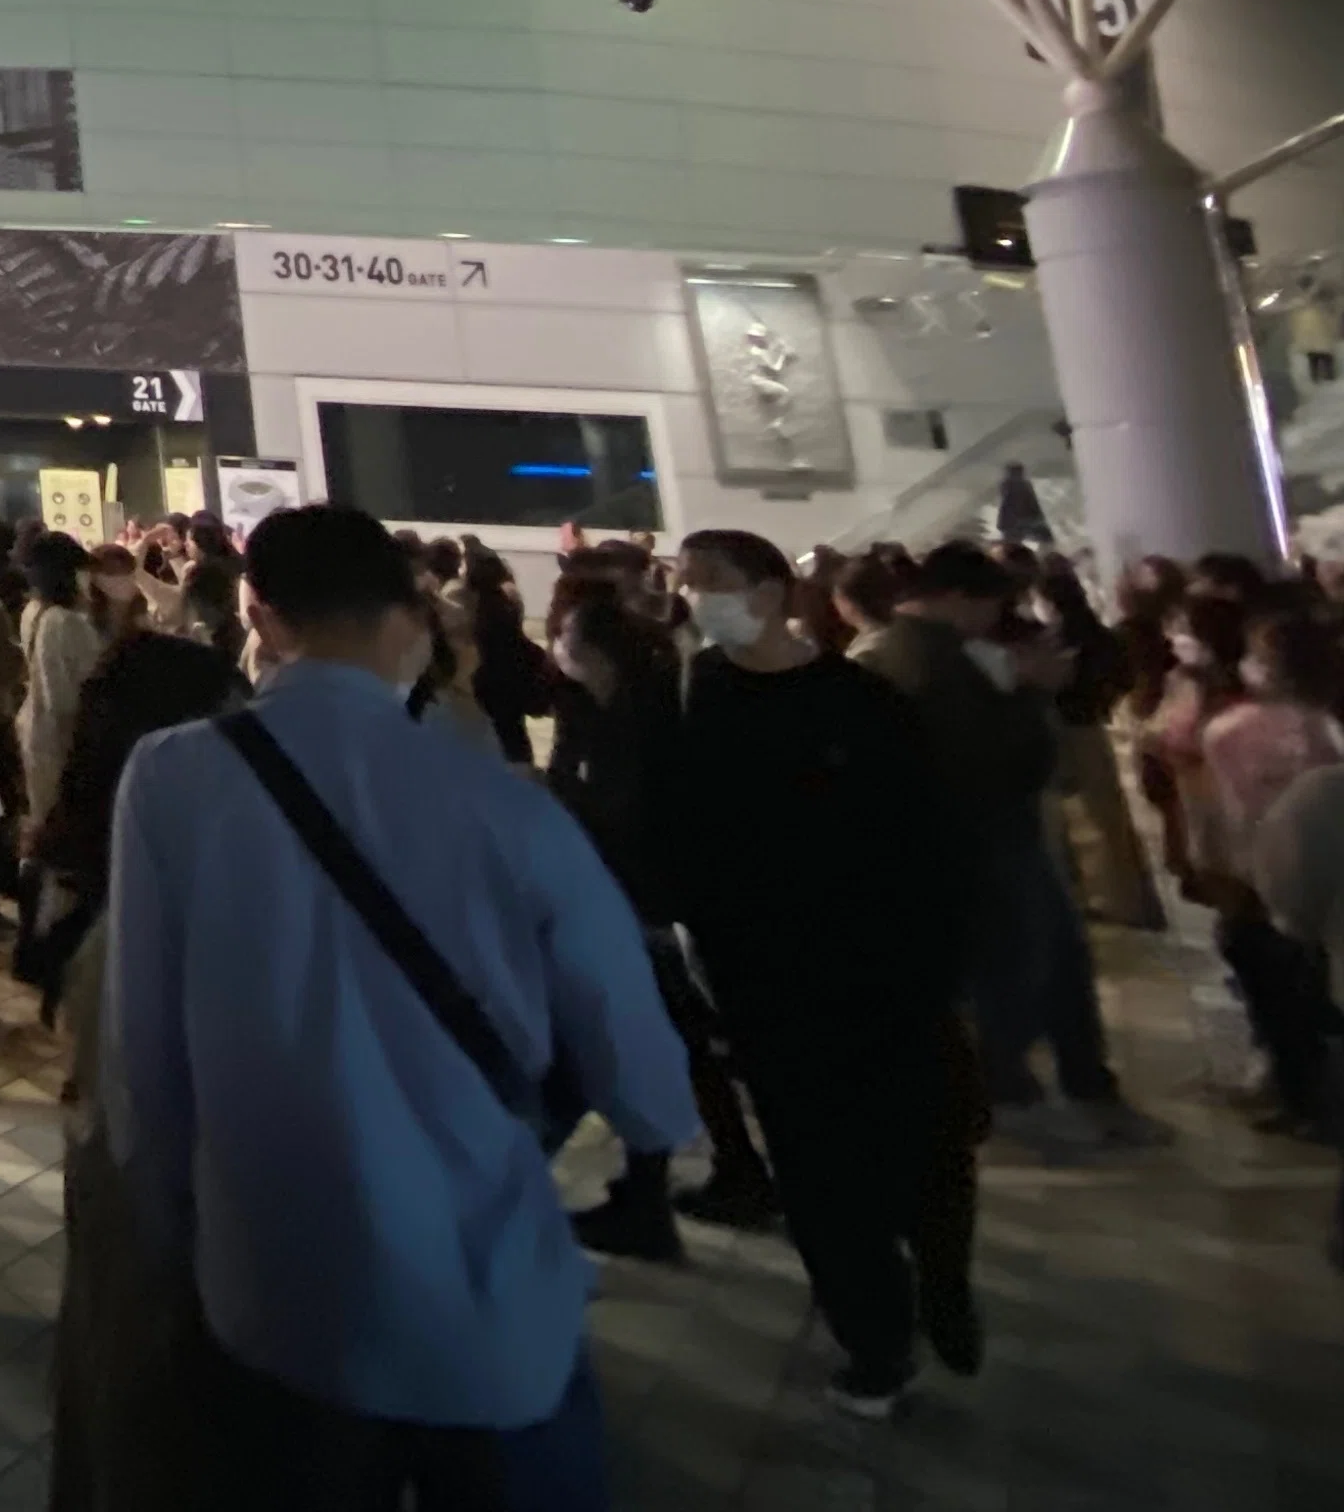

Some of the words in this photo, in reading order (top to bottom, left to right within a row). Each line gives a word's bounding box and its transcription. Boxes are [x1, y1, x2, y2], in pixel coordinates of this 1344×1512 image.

[407, 273, 448, 287] GATE
[131, 376, 163, 400] 21
[131, 400, 167, 413] GATE
